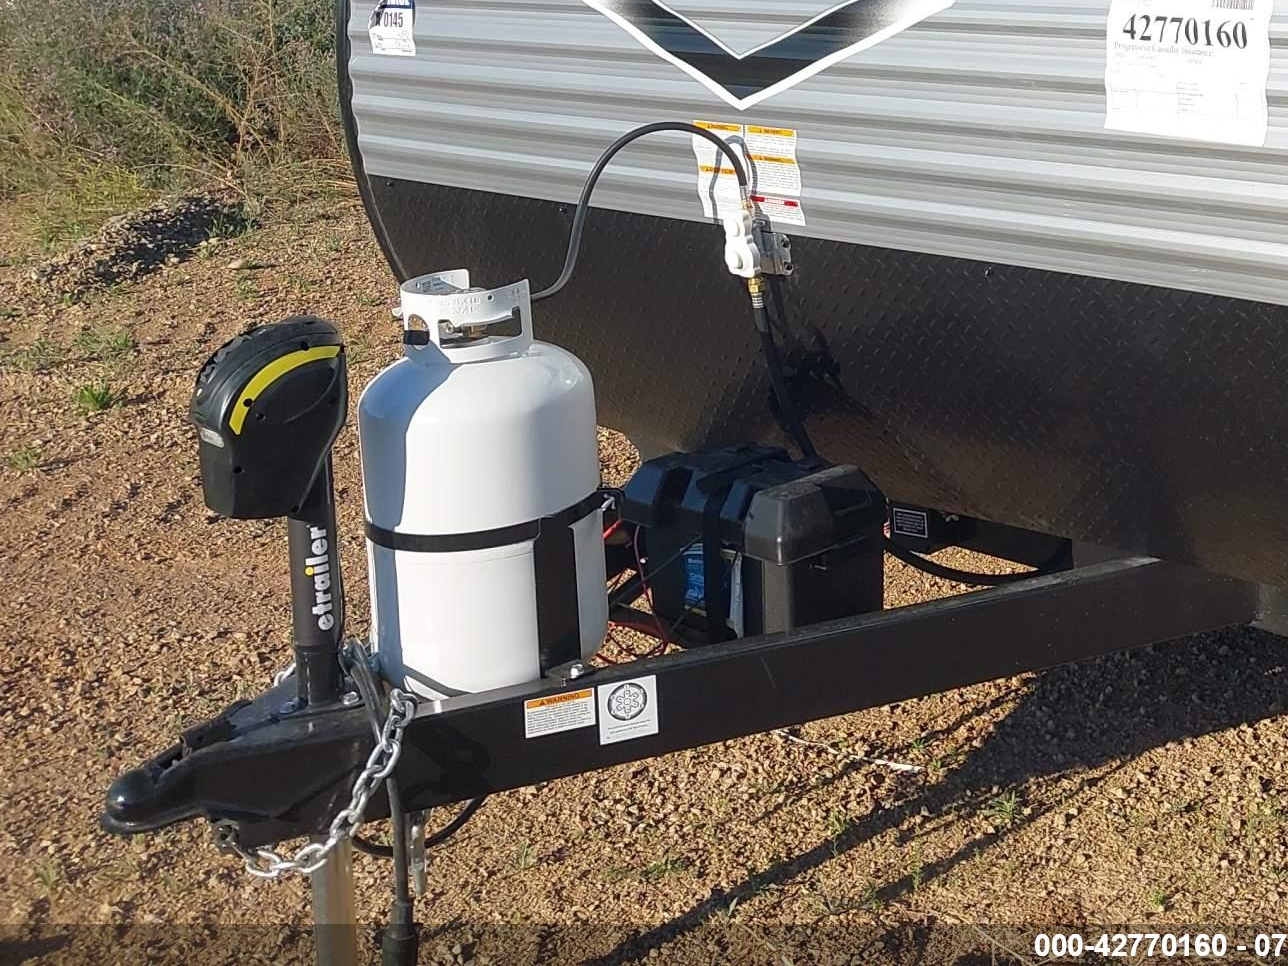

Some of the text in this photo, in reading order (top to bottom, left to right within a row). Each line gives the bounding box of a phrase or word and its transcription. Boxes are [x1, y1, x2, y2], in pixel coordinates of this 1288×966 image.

[383, 11, 404, 28] 0145
[1122, 13, 1248, 49] 42770160
[305, 527, 335, 631] etrailer
